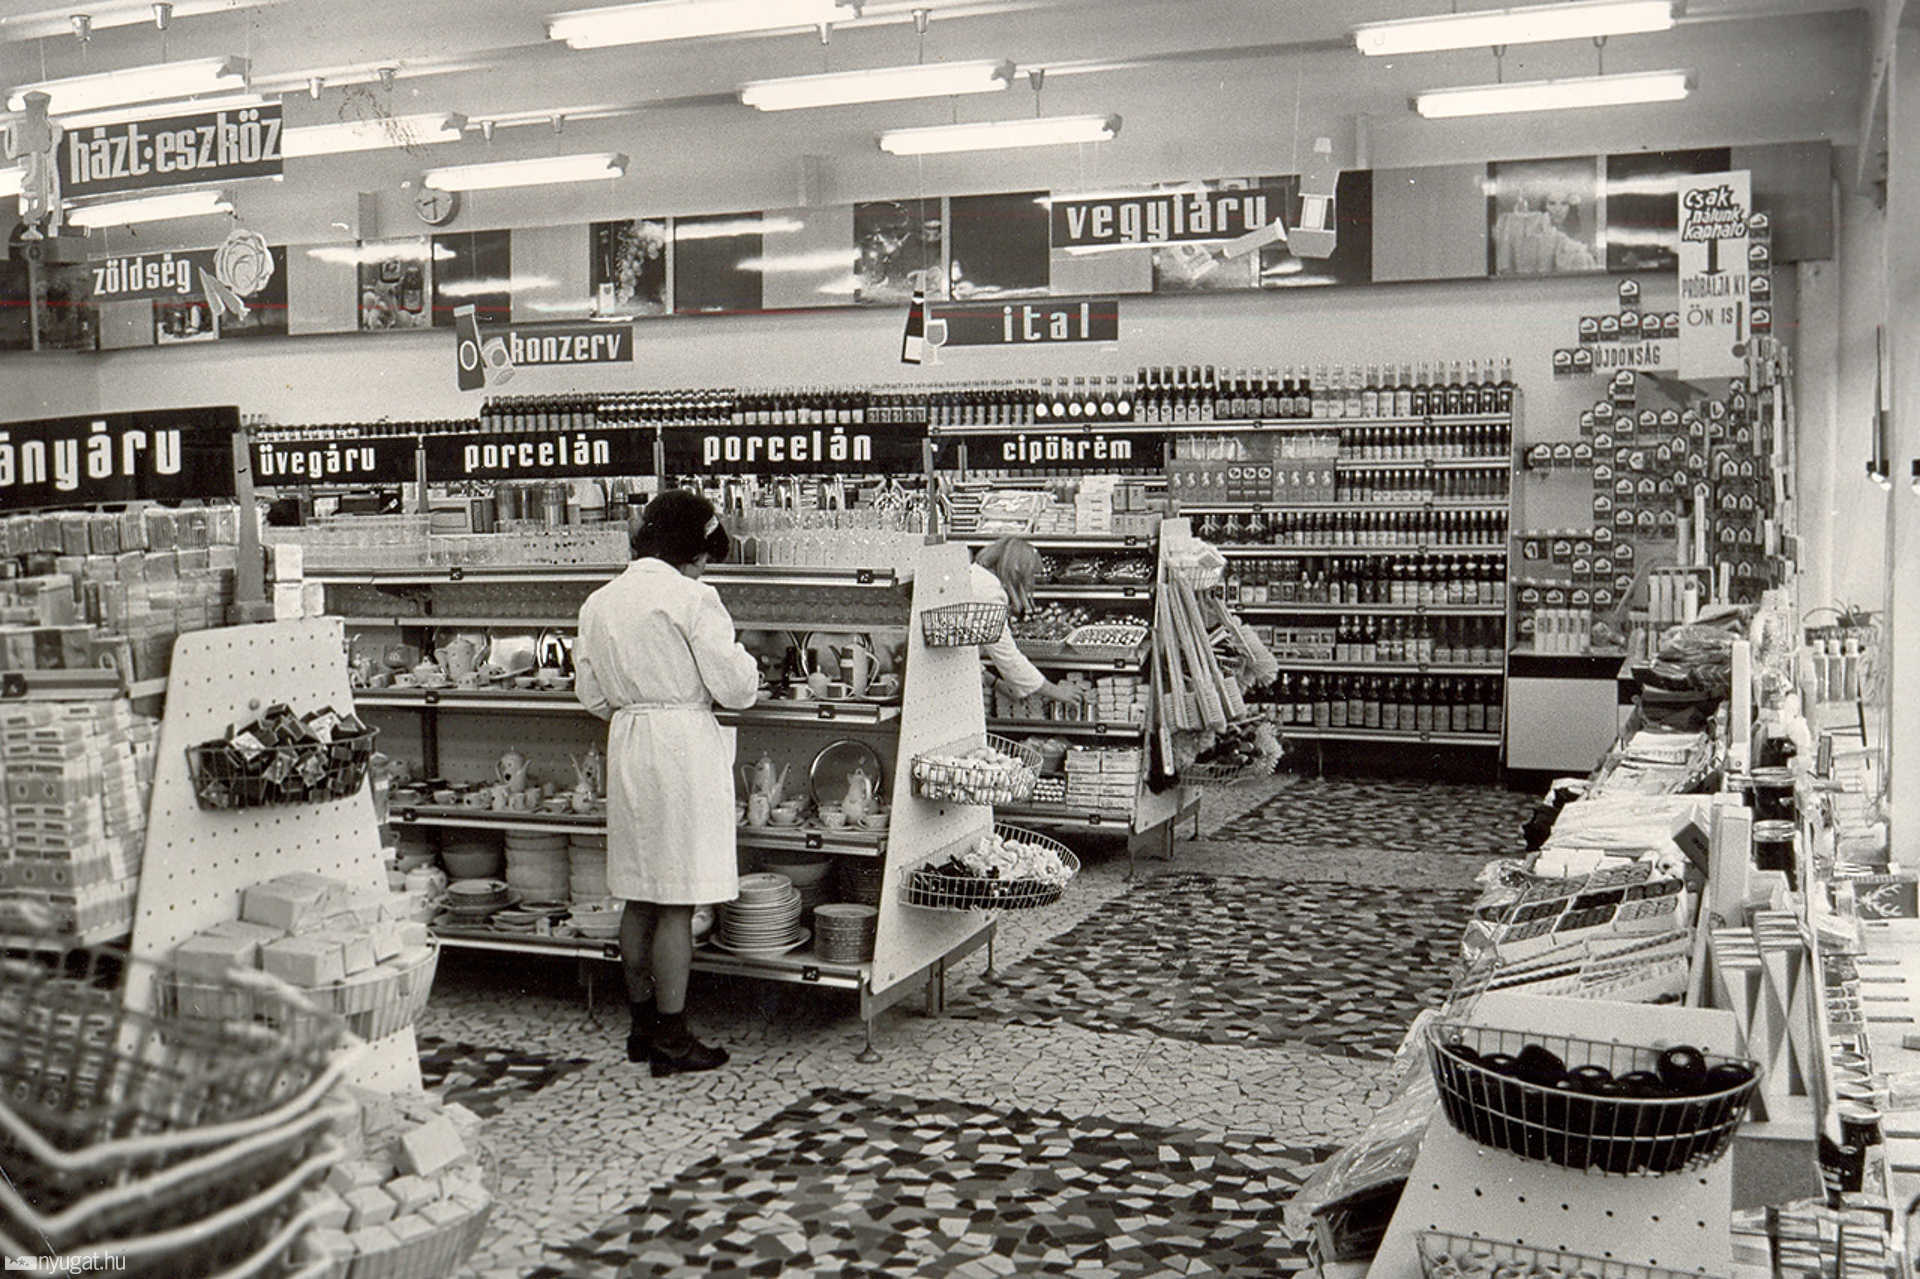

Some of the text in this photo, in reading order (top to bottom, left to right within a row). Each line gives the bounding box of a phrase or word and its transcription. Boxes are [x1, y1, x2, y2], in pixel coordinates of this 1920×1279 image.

[1066, 192, 1267, 244] vegyláru
[92, 252, 191, 296] zöldség
[1003, 302, 1089, 342] ital
[1687, 303, 1713, 326] ÖN
[510, 331, 621, 364] konzerv
[259, 443, 376, 478] üvegáru
[464, 433, 610, 473] porcelán
[703, 427, 872, 465] porcelán
